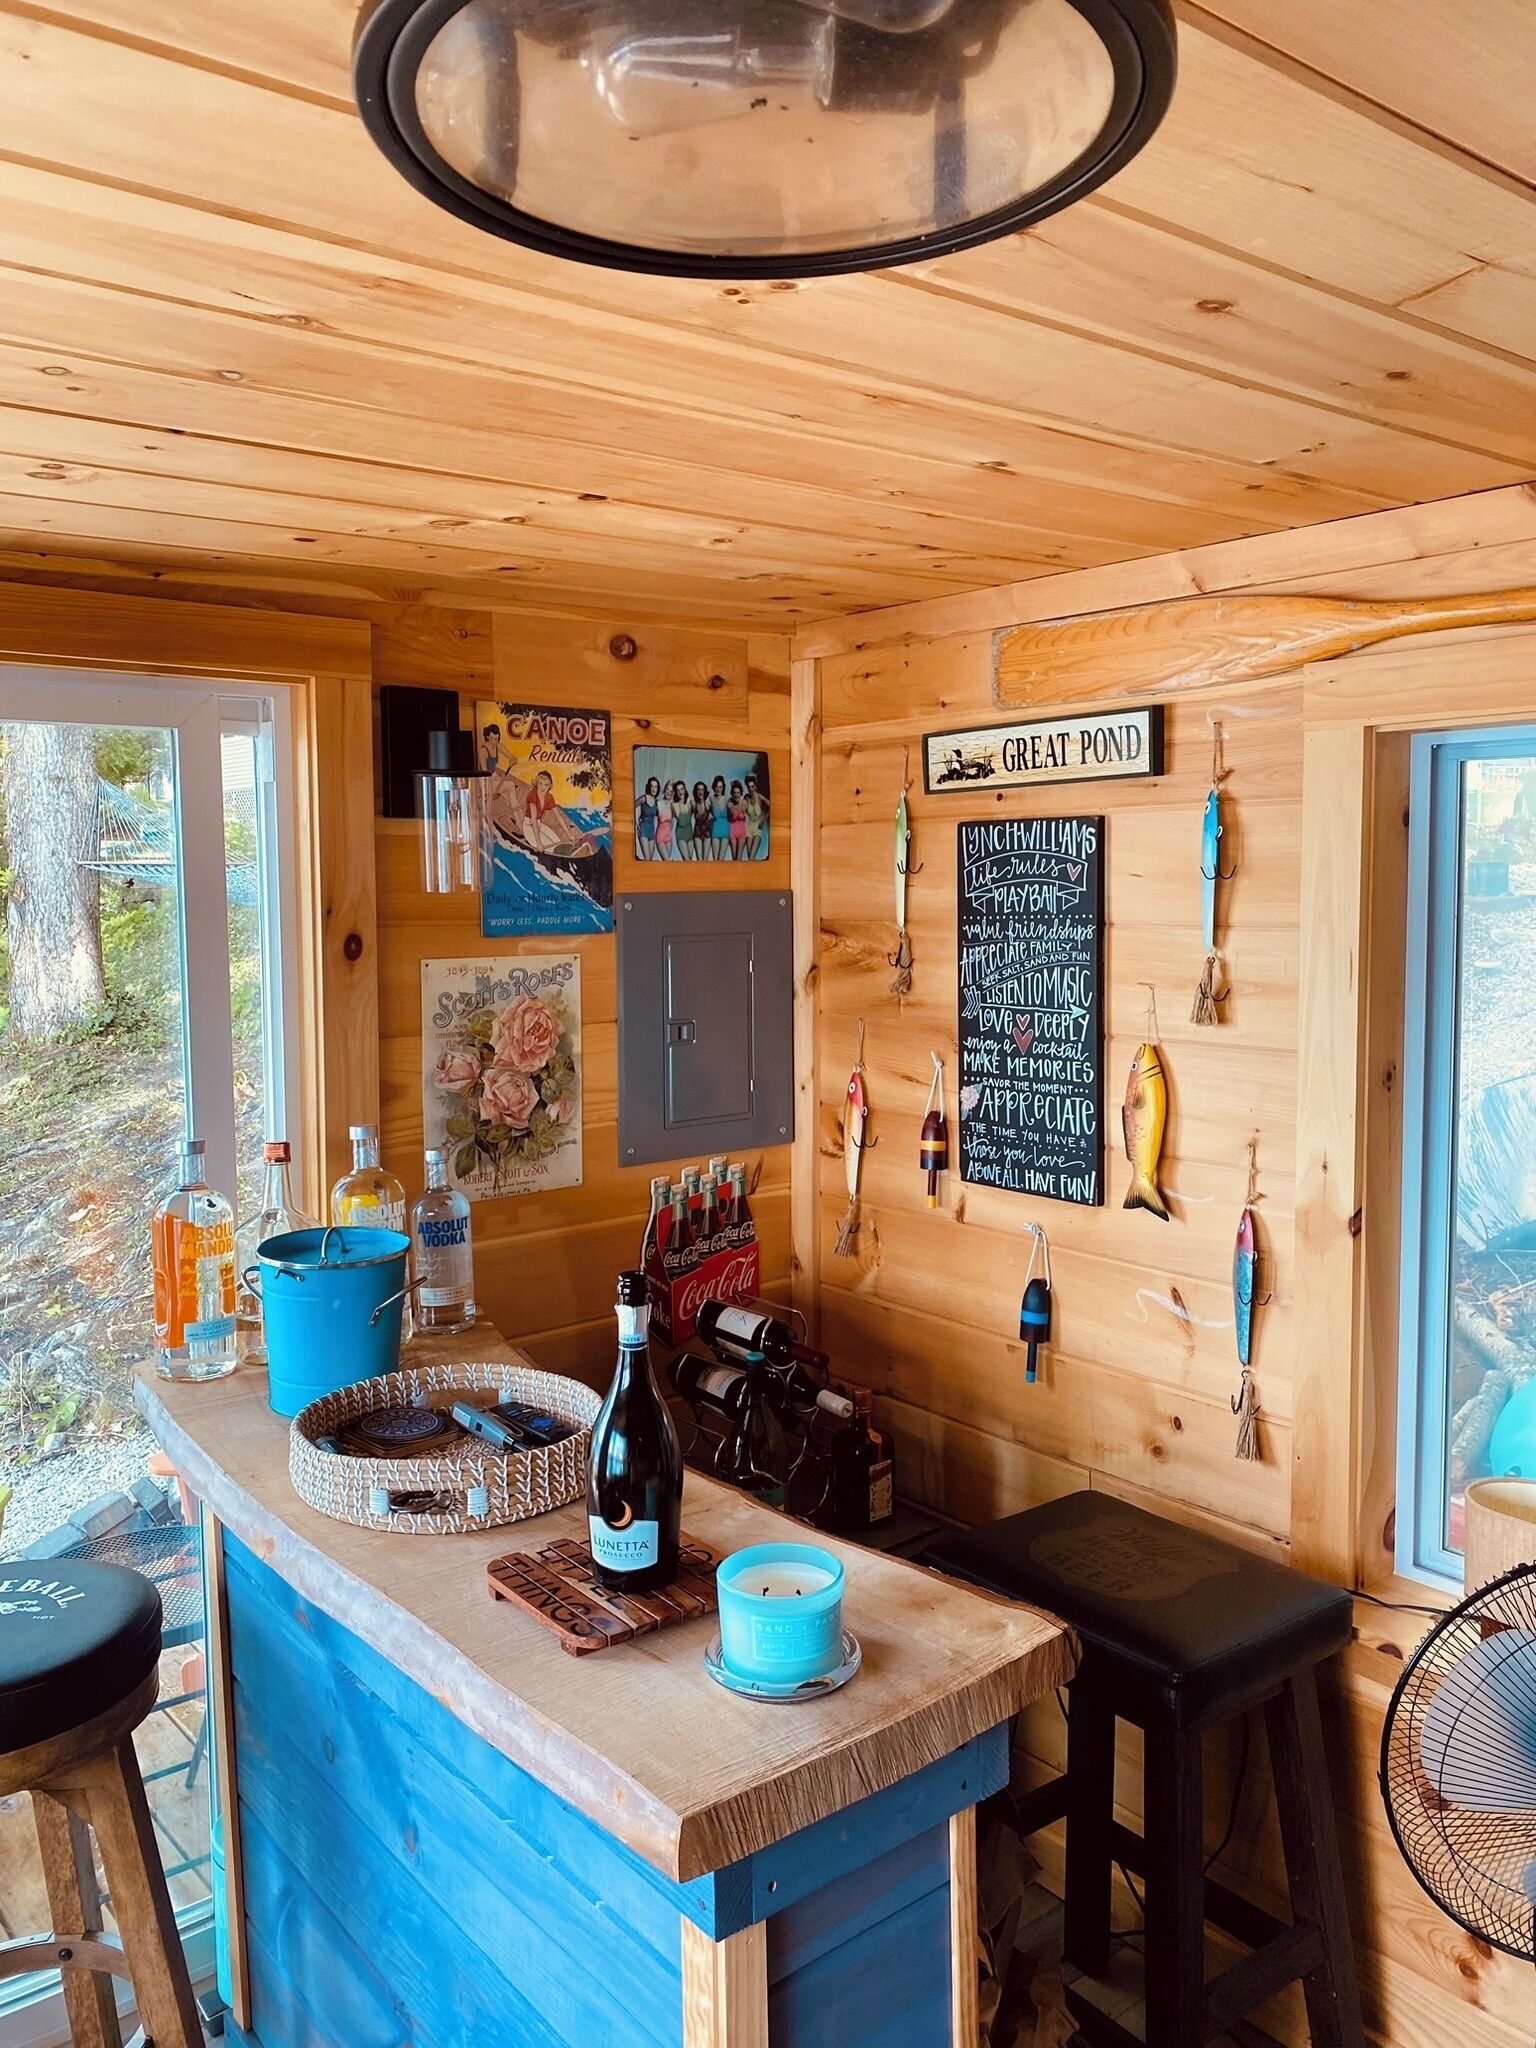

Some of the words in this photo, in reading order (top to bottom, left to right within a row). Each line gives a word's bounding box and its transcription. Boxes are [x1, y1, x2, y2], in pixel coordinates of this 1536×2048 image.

[506, 713, 606, 745] CANOE
[529, 744, 581, 764] Rental
[1002, 732, 1070, 773] GREAT
[1079, 724, 1142, 766] POND
[969, 865, 1008, 891] life
[1006, 853, 1066, 879] rules
[537, 916, 561, 925] PADDLE
[963, 919, 1004, 941] value
[1005, 919, 1096, 949] friendships
[1030, 941, 1073, 954] FAMILY
[1024, 955, 1048, 970] SAND
[1049, 953, 1070, 963] AND
[1072, 951, 1091, 962] FUN
[986, 974, 1025, 1006] LISTEN
[1025, 972, 1042, 1006] TO
[1043, 965, 1093, 1009] MUSIC
[963, 1035, 1002, 1063] enjoy
[1003, 1038, 1016, 1055] a
[1032, 1040, 1089, 1061] cocktail
[963, 1051, 1000, 1075] MAKE
[1007, 1056, 1094, 1083] MEMORIES
[982, 1076, 1011, 1088] SAVOR
[1012, 1080, 1030, 1091] THE
[1032, 1081, 1073, 1095] MOMENT
[969, 1121, 987, 1134] THE
[992, 1125, 1017, 1138] TIME
[1022, 1128, 1040, 1143] YOU
[1046, 1132, 1077, 1148] HAVE
[1003, 1145, 1031, 1168] you
[1033, 1145, 1086, 1168] love
[967, 1160, 1001, 1184] ABOVE
[1025, 1169, 1057, 1195] HAVE
[1060, 1170, 1096, 1205] FUN!
[418, 1216, 468, 1235] ABSOLUT
[422, 1230, 466, 1247] VODKA
[593, 1534, 649, 1552] LUNETTA
[599, 1548, 643, 1559] PROSECCO
[490, 1557, 612, 1638] THINGS
